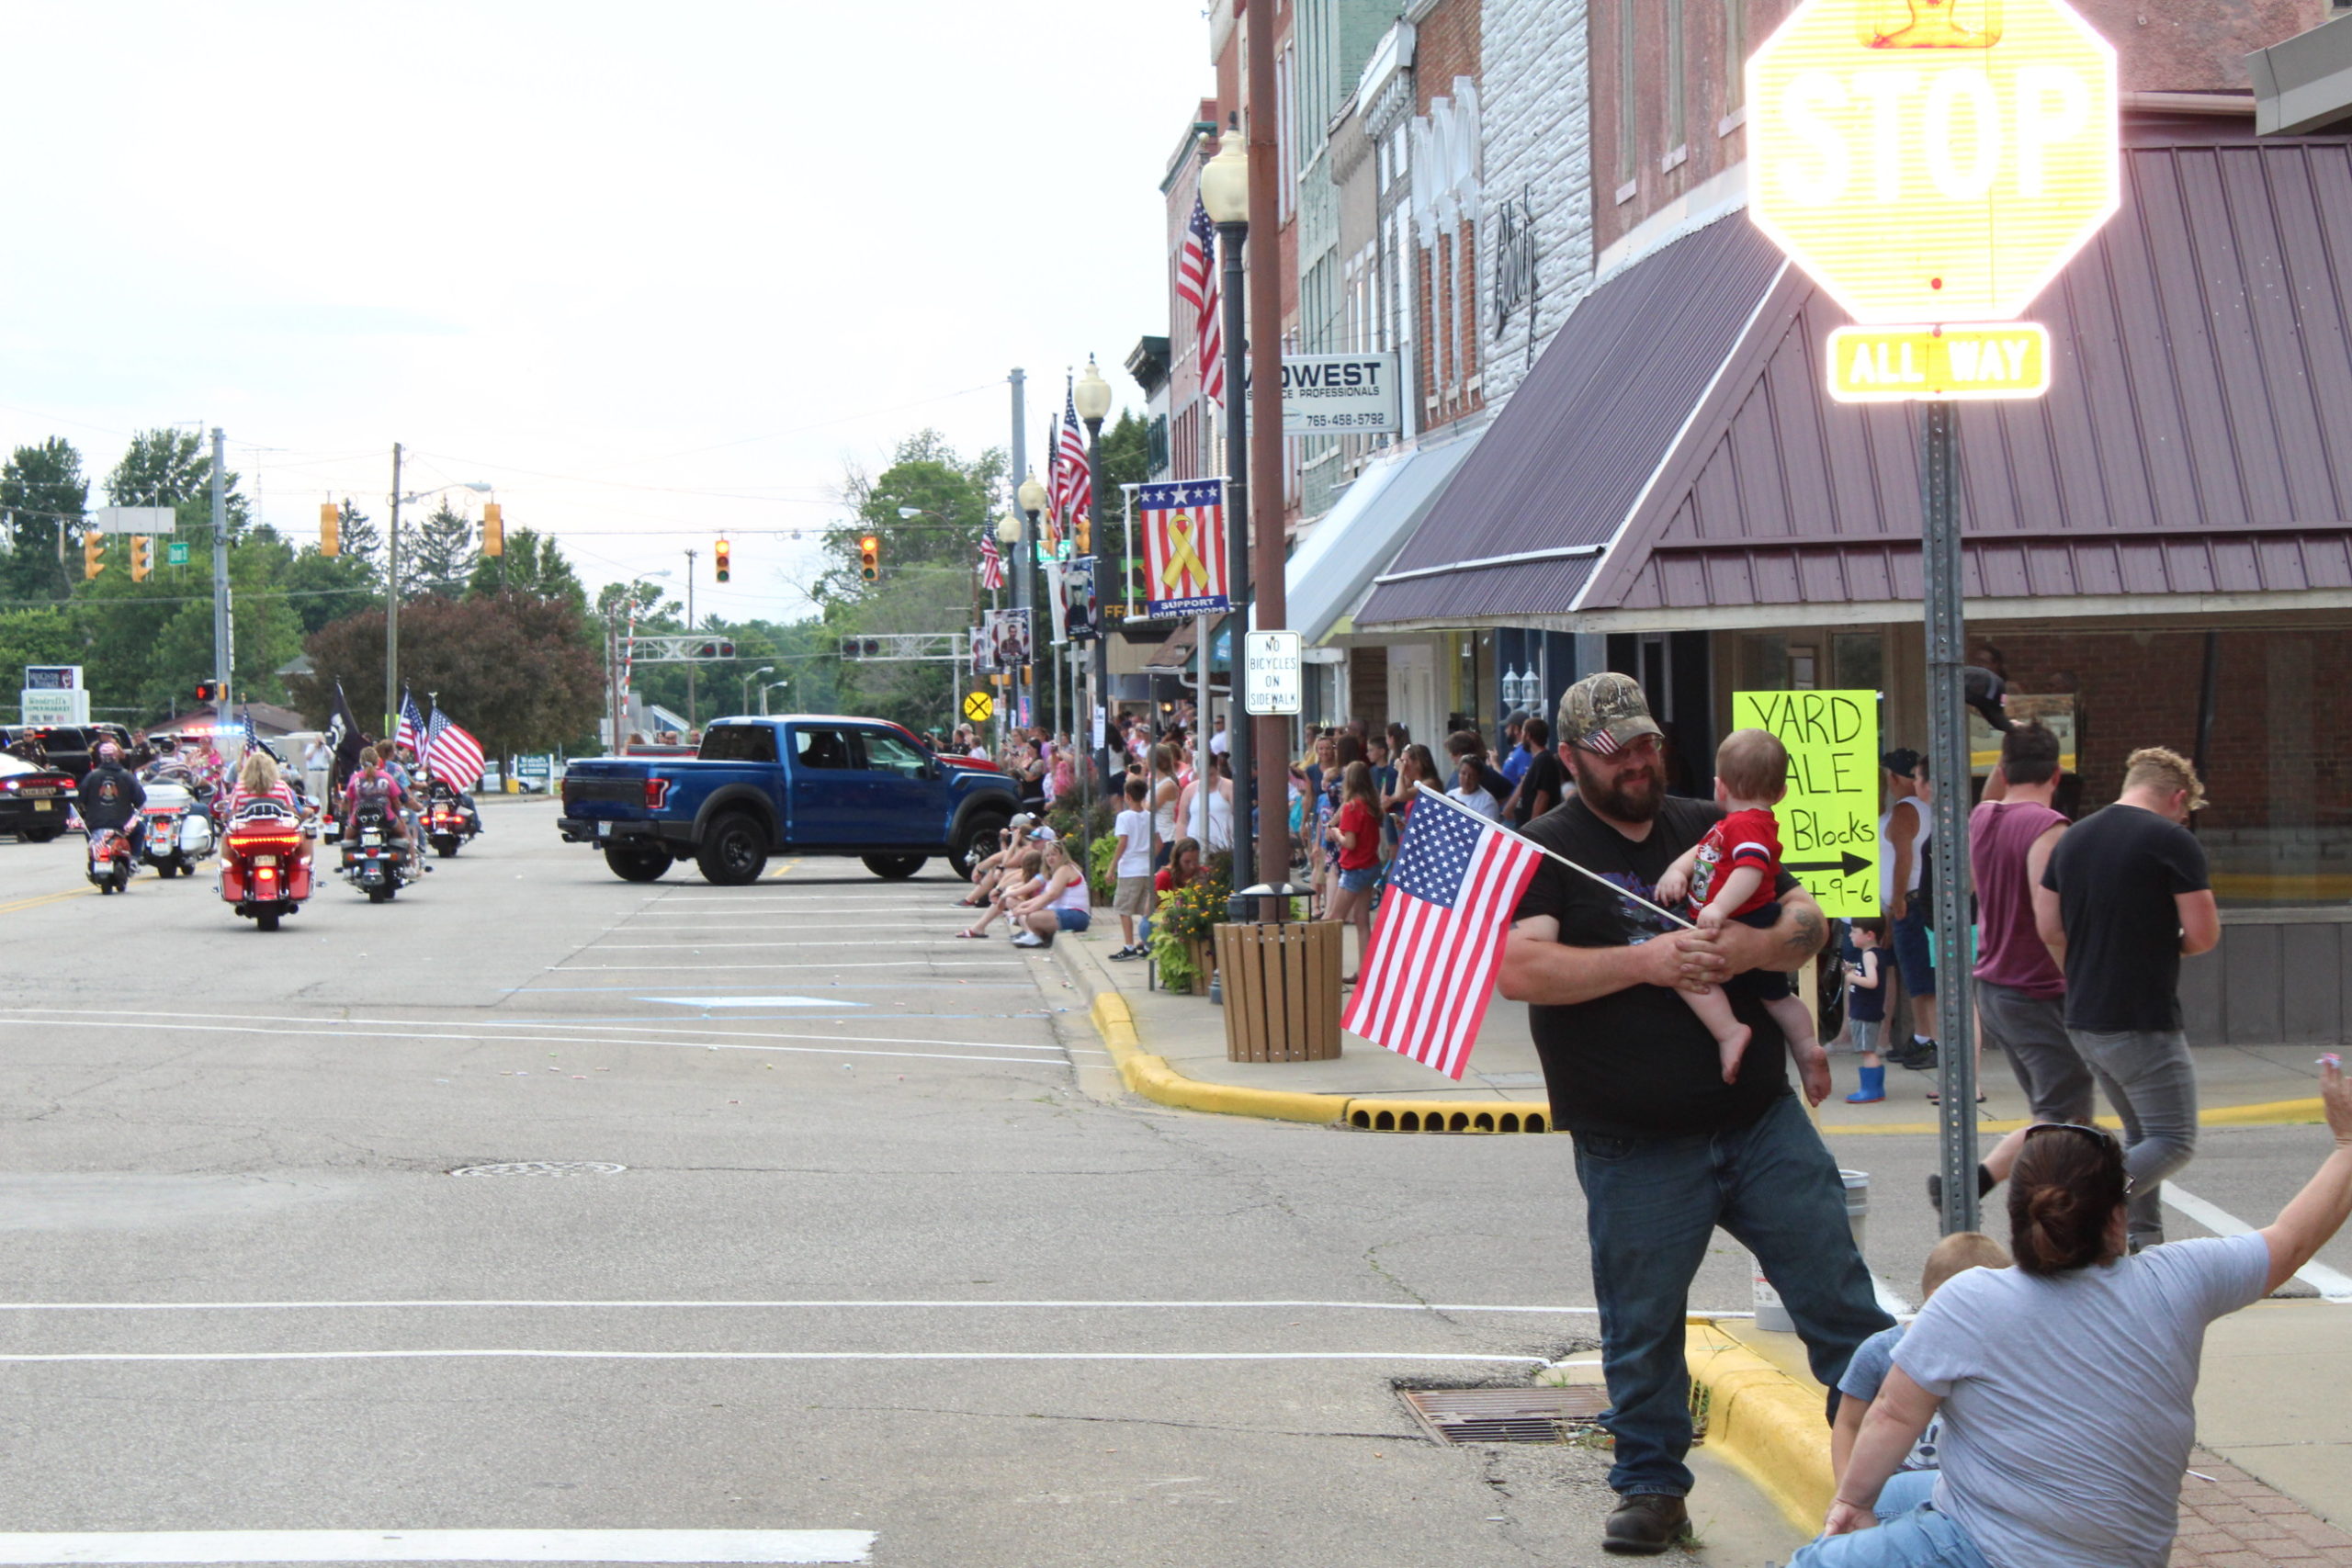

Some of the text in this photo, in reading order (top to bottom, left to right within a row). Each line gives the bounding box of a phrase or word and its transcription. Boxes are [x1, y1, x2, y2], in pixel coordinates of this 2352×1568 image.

[1775, 67, 2090, 206] STOP
[1849, 340, 2029, 383] ALL WAY
[1244, 362, 1381, 389] WEST
[1300, 387, 1379, 399] PROFESSIONALS
[1160, 598, 1215, 610] SUPPORT
[1179, 606, 1226, 617] TROOPS
[1265, 639, 1280, 652] NO
[1250, 657, 1296, 670] BICYCLES
[1265, 675, 1280, 687] ON
[1250, 693, 1296, 705] SIDEWALK
[1749, 694, 1861, 745] YARD
[1786, 753, 1862, 795] ALE
[1792, 808, 1875, 851] Blocks
